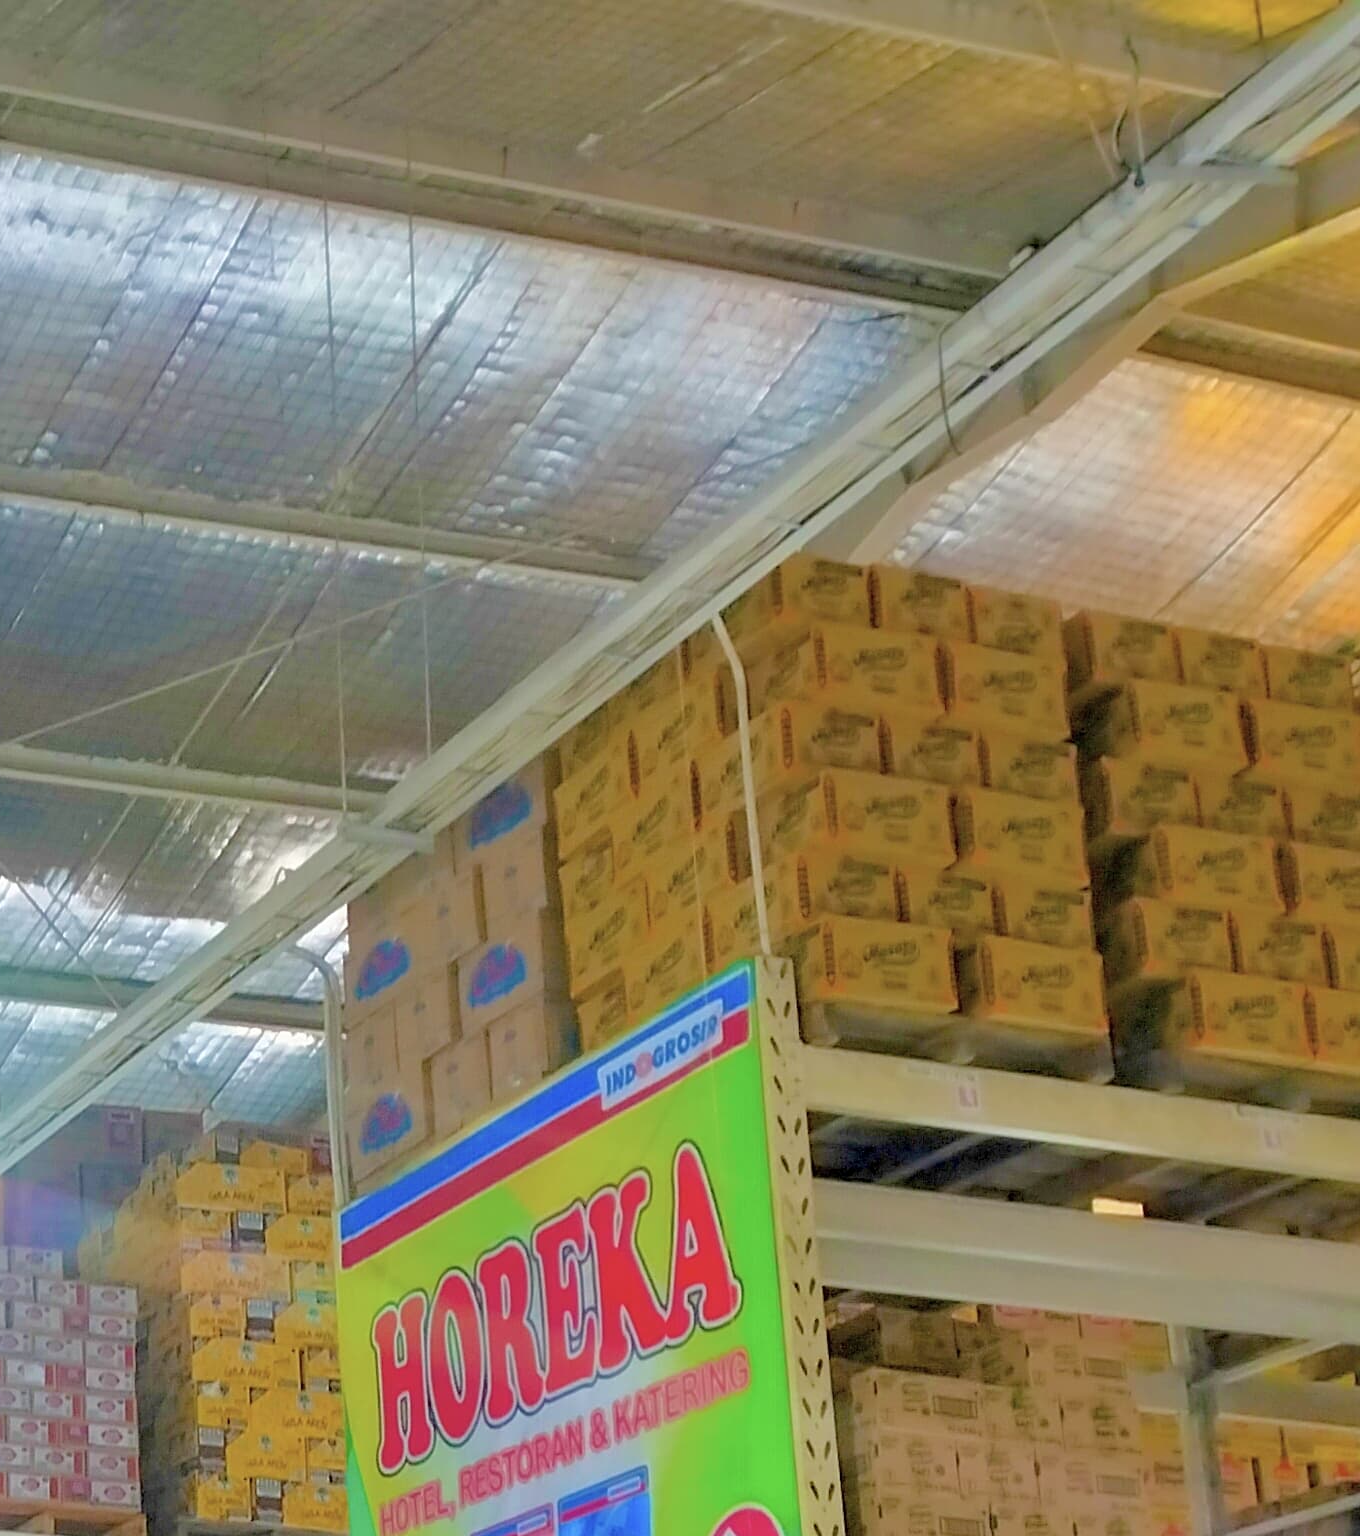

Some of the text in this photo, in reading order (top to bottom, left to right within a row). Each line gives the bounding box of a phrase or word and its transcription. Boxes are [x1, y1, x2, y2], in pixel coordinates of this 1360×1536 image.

[602, 1012, 721, 1098] INDOGROSIR
[372, 1140, 743, 1475] HOREKA
[459, 1422, 585, 1508] RESTORAN
[589, 1413, 610, 1451] &
[613, 1346, 751, 1441] KATERING
